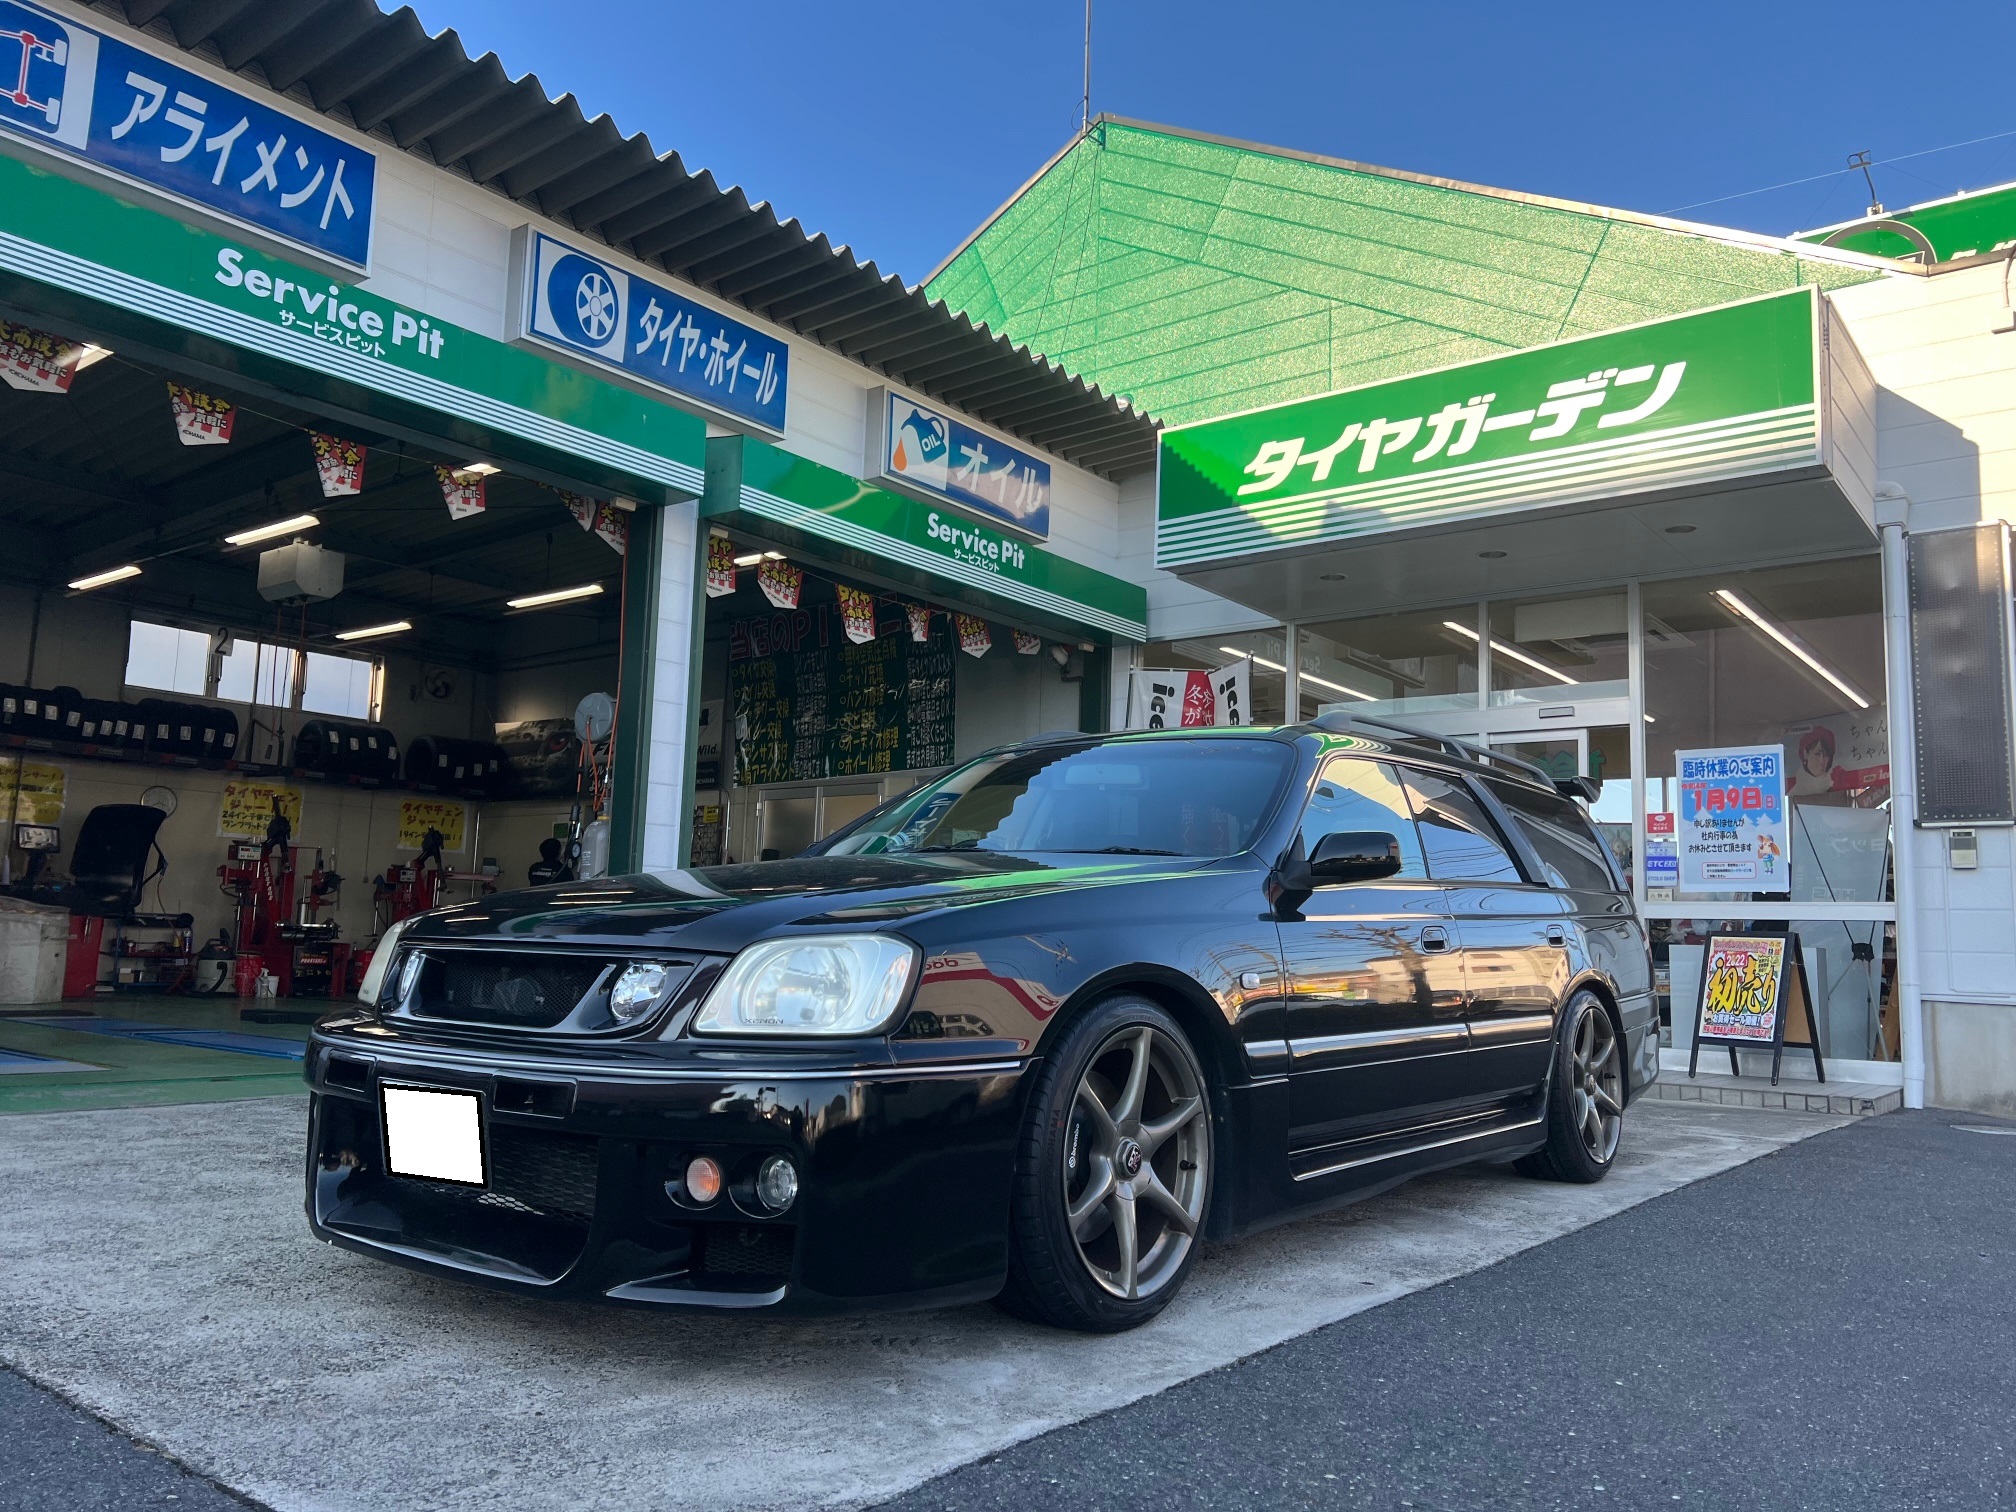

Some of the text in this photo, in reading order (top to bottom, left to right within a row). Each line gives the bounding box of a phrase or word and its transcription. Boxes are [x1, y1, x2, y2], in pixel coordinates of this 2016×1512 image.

[111, 71, 354, 230] アライメント
[215, 247, 445, 360] Service Pit
[279, 309, 386, 357] サービスピット
[636, 297, 779, 405] タイヤ・ホイール
[8, 368, 39, 386] YOKOHAMA
[921, 435, 941, 452] OIL
[1237, 361, 1687, 495] タイヤガーデン
[955, 442, 1043, 514] オイル
[926, 513, 1025, 569] Service Pit
[953, 548, 1000, 572] サービスピット
[215, 627, 228, 655] 2
[1682, 757, 1775, 779] 臨時休業のご案内
[402, 803, 464, 817] タイヤチェン
[1694, 818, 1745, 828] 申し訳ありませんが
[1688, 843, 1752, 853] お休みとさせて頂きます
[1071, 1123, 1080, 1157] brembo
